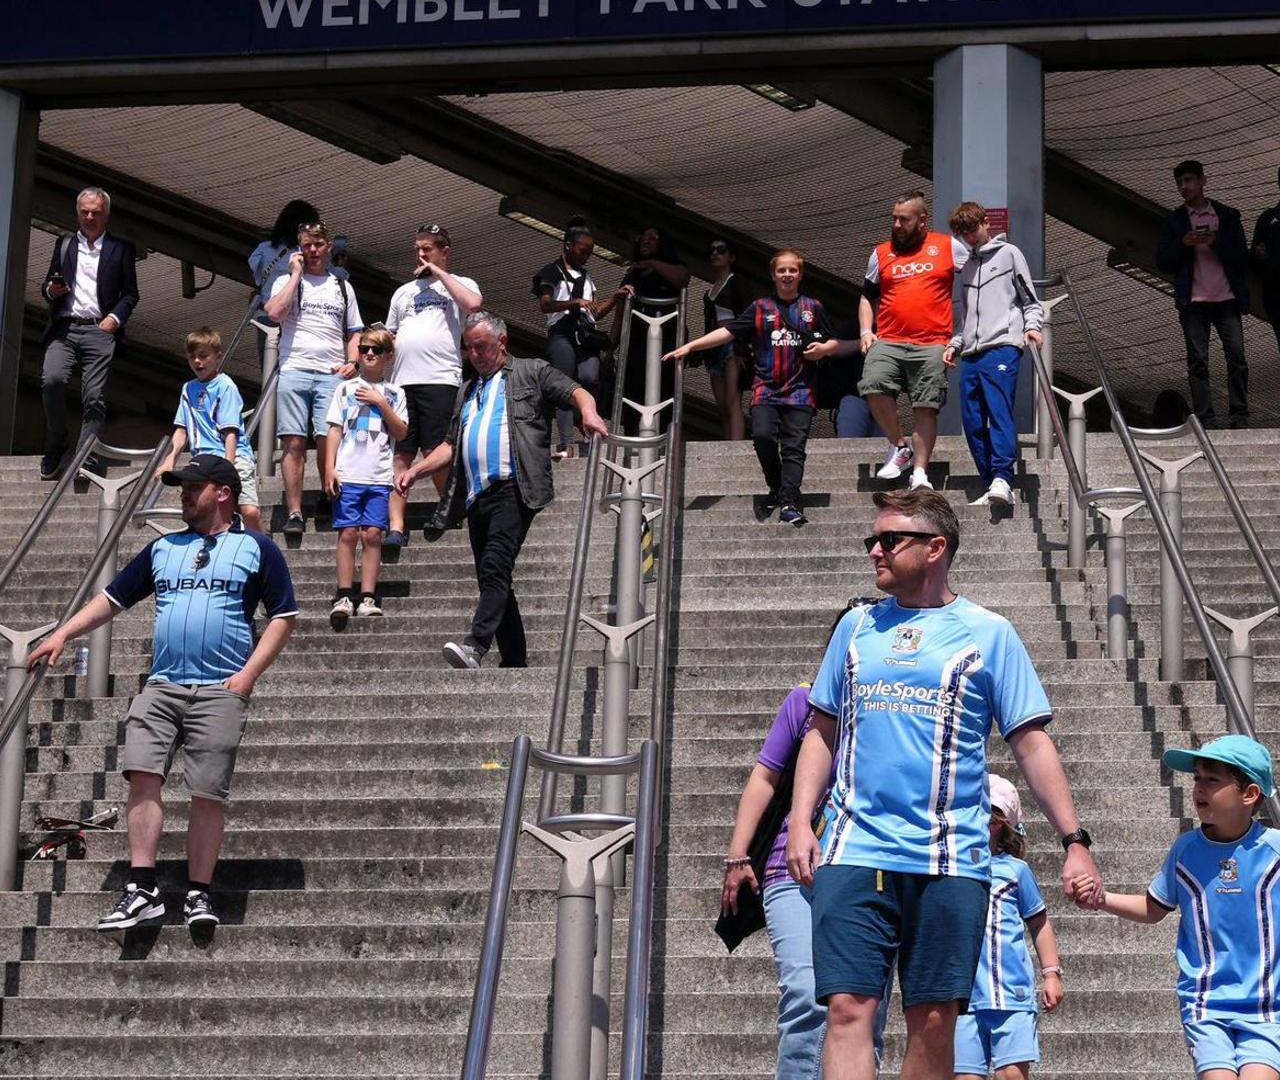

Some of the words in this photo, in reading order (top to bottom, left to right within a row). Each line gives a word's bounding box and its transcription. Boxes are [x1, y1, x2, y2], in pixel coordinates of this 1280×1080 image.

[892, 262, 934, 275] indigo
[156, 578, 241, 594] SUBARU
[863, 701, 886, 711] THIS
[888, 702, 900, 712] IS
